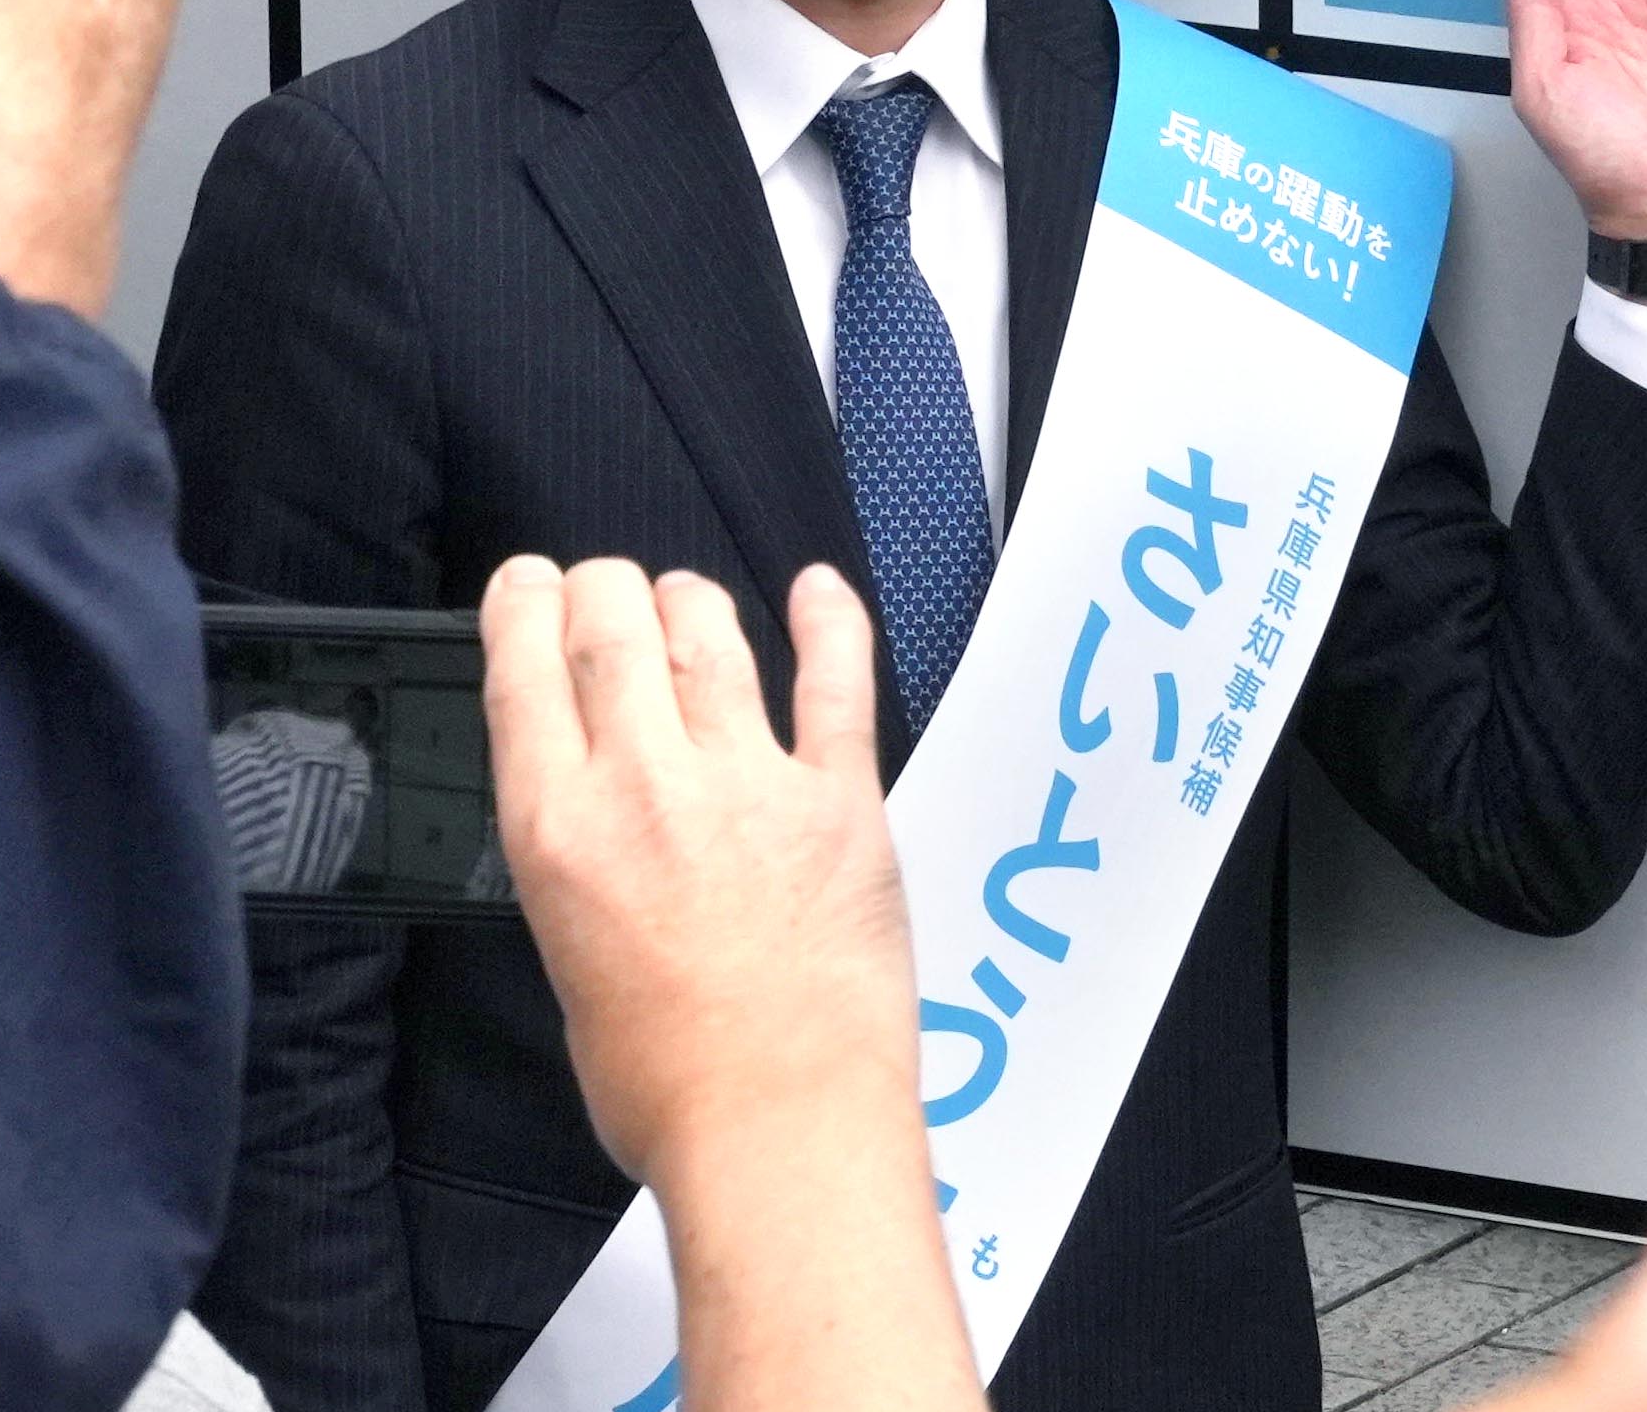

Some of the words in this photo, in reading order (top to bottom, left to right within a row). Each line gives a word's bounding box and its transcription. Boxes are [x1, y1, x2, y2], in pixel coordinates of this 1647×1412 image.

[1158, 109, 1393, 263] 兵庫の躍動を
[1173, 175, 1360, 303] 止めない!
[1179, 470, 1338, 819] 兵庫県知事候補
[919, 446, 1249, 1215] さいとう
